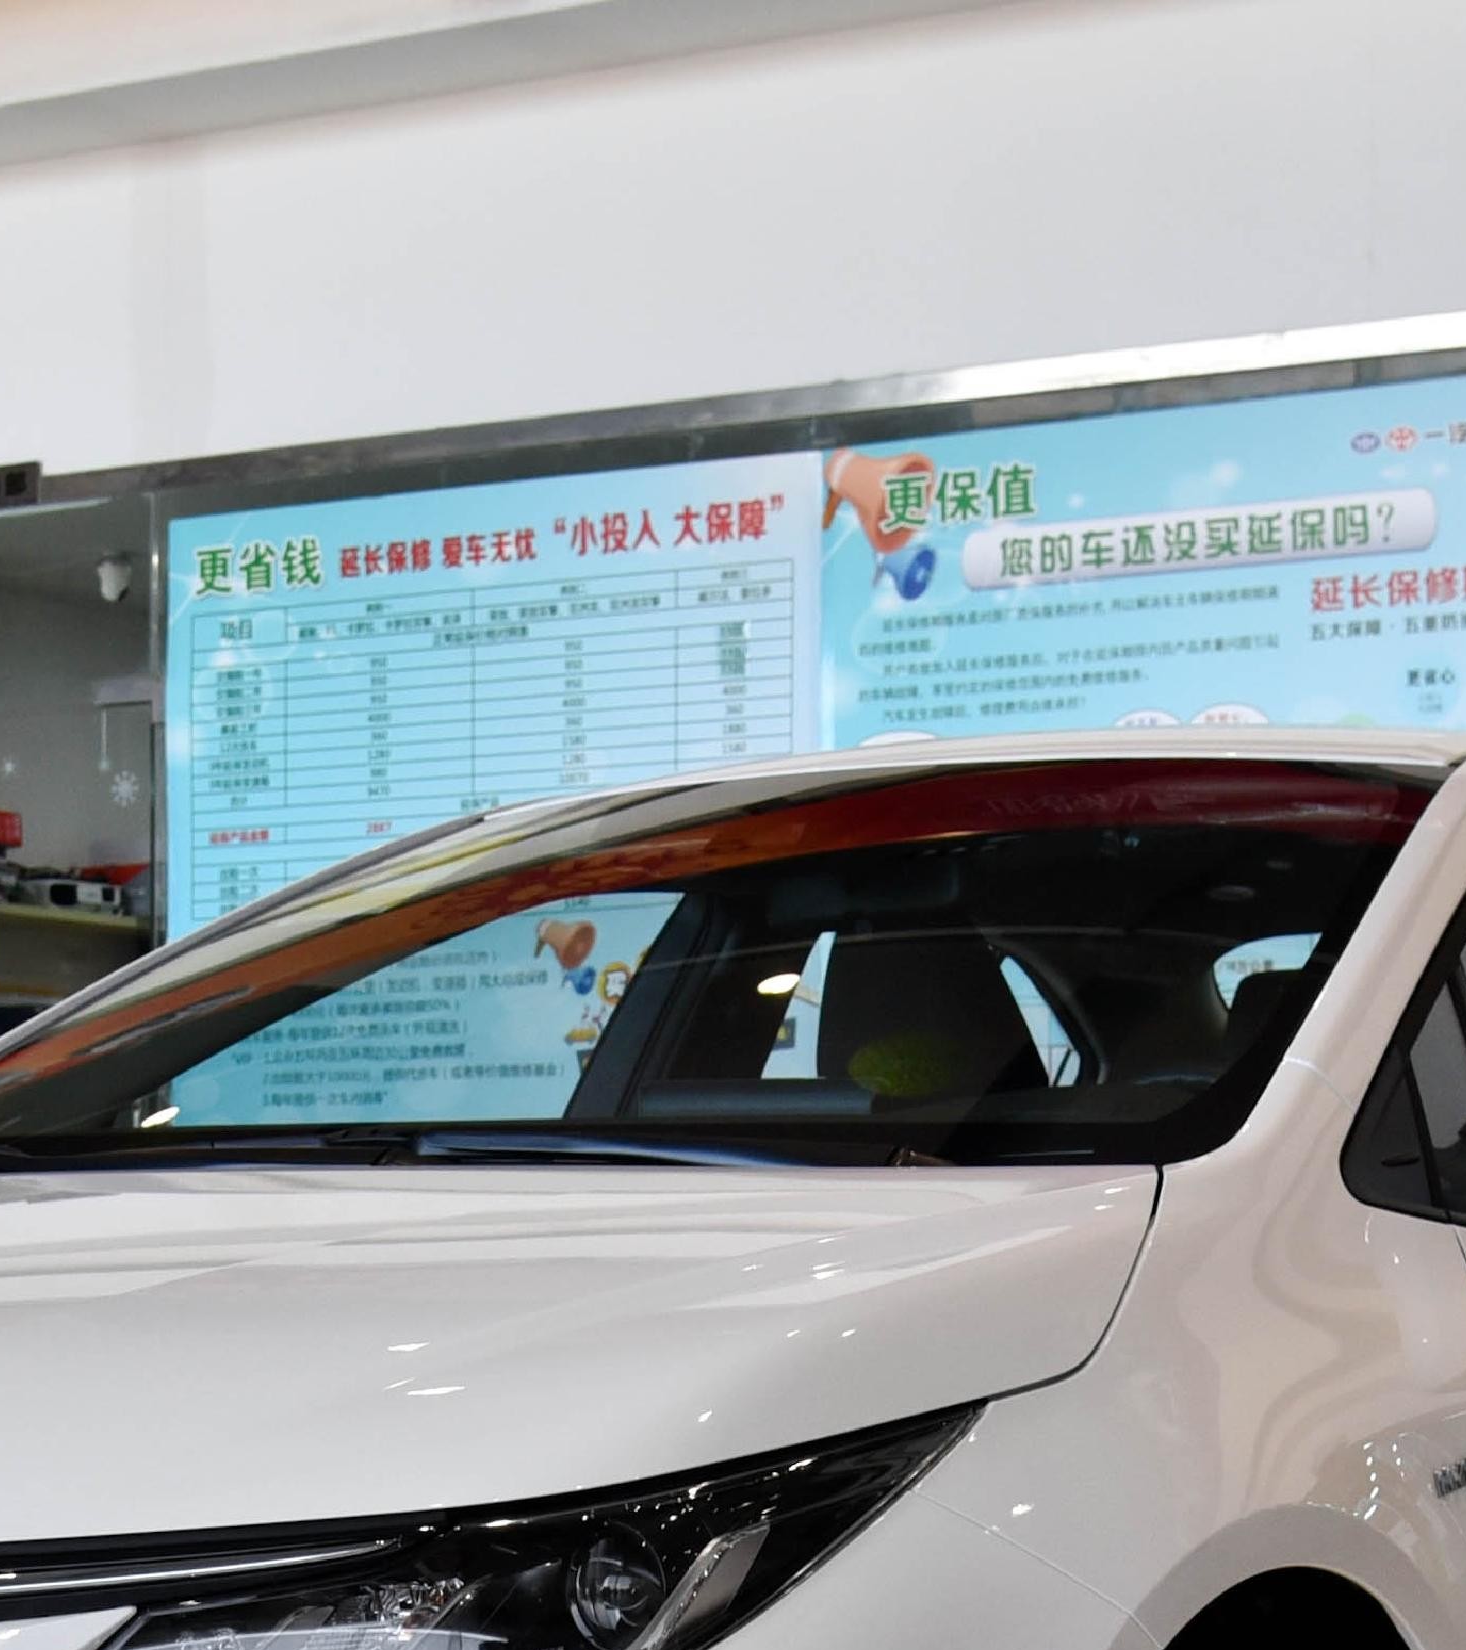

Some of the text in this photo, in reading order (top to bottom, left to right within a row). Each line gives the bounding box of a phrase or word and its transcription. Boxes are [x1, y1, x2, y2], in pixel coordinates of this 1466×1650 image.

[882, 463, 1036, 528] 更保值
[195, 535, 323, 596] 更省钱
[339, 539, 432, 578] 延长保修
[442, 527, 536, 569] 爱车无忧
